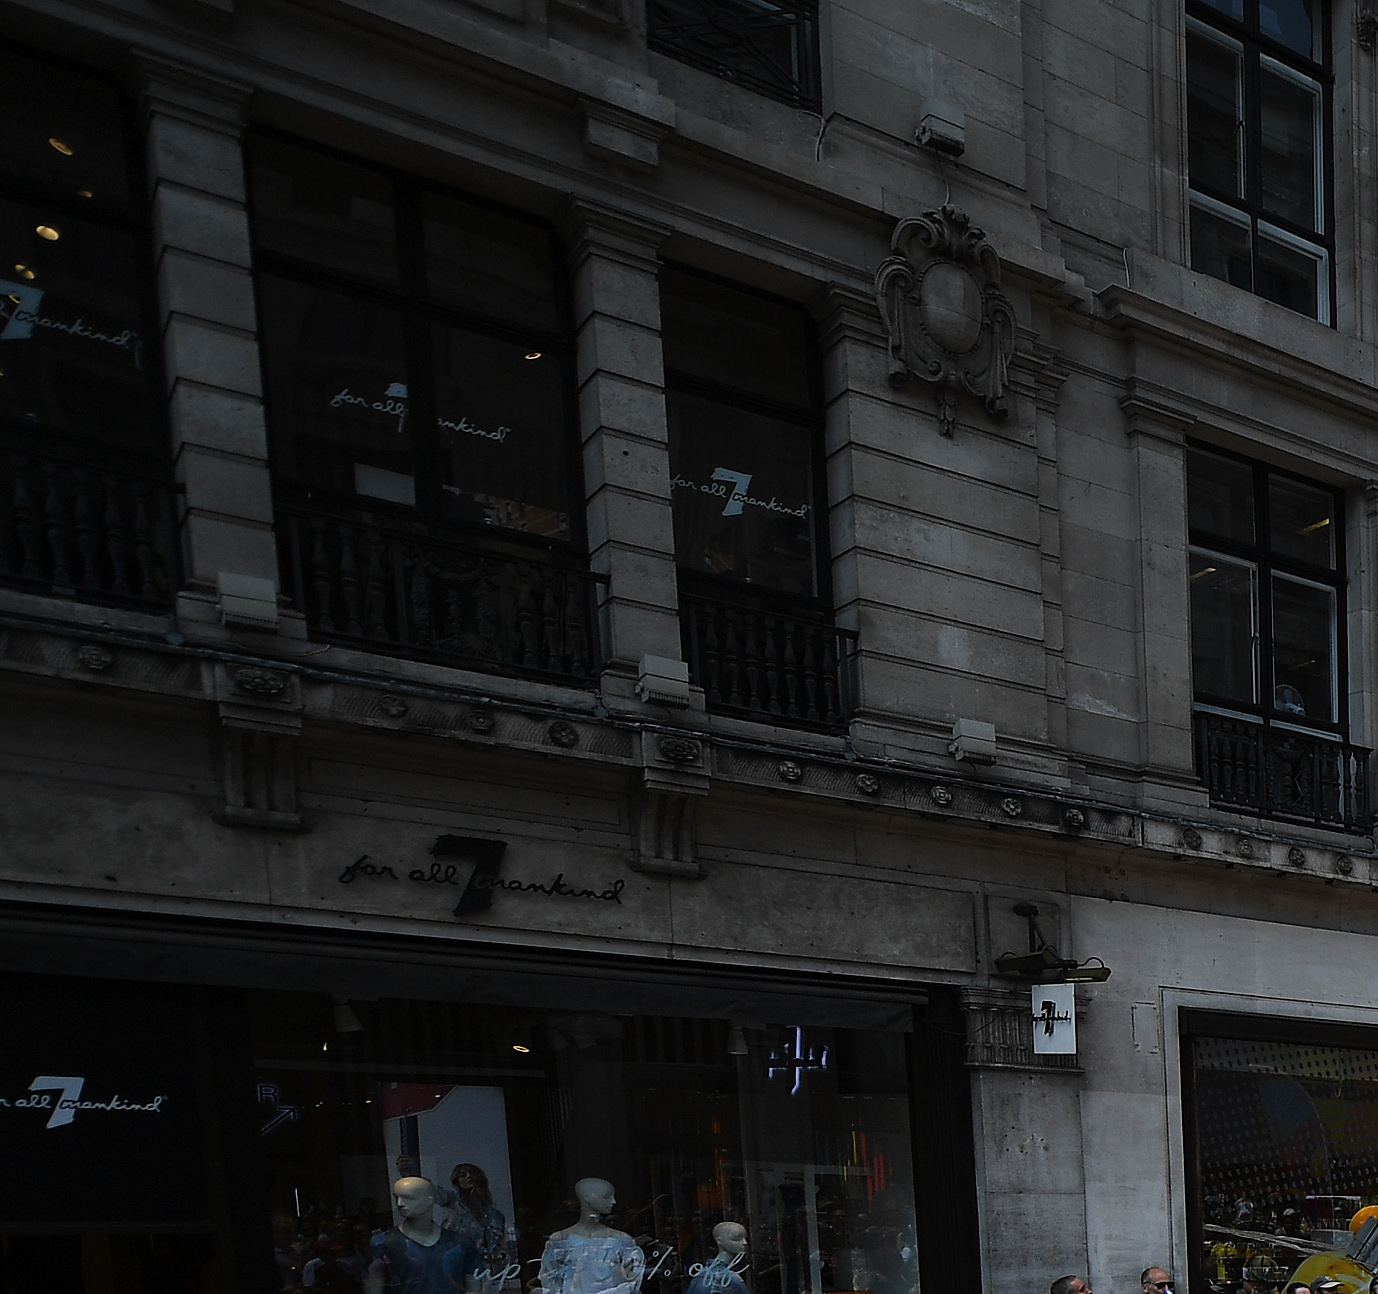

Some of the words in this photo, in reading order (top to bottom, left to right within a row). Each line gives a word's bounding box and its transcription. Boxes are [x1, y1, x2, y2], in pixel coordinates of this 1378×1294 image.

[733, 491, 807, 519] mankind
[340, 855, 398, 884] for
[408, 863, 458, 885] all
[430, 833, 508, 917] 7
[474, 873, 625, 906] mankind
[17, 1094, 52, 1110] all
[60, 1095, 163, 1113] mankind
[29, 1075, 85, 1129] 7
[688, 1250, 750, 1288] off
